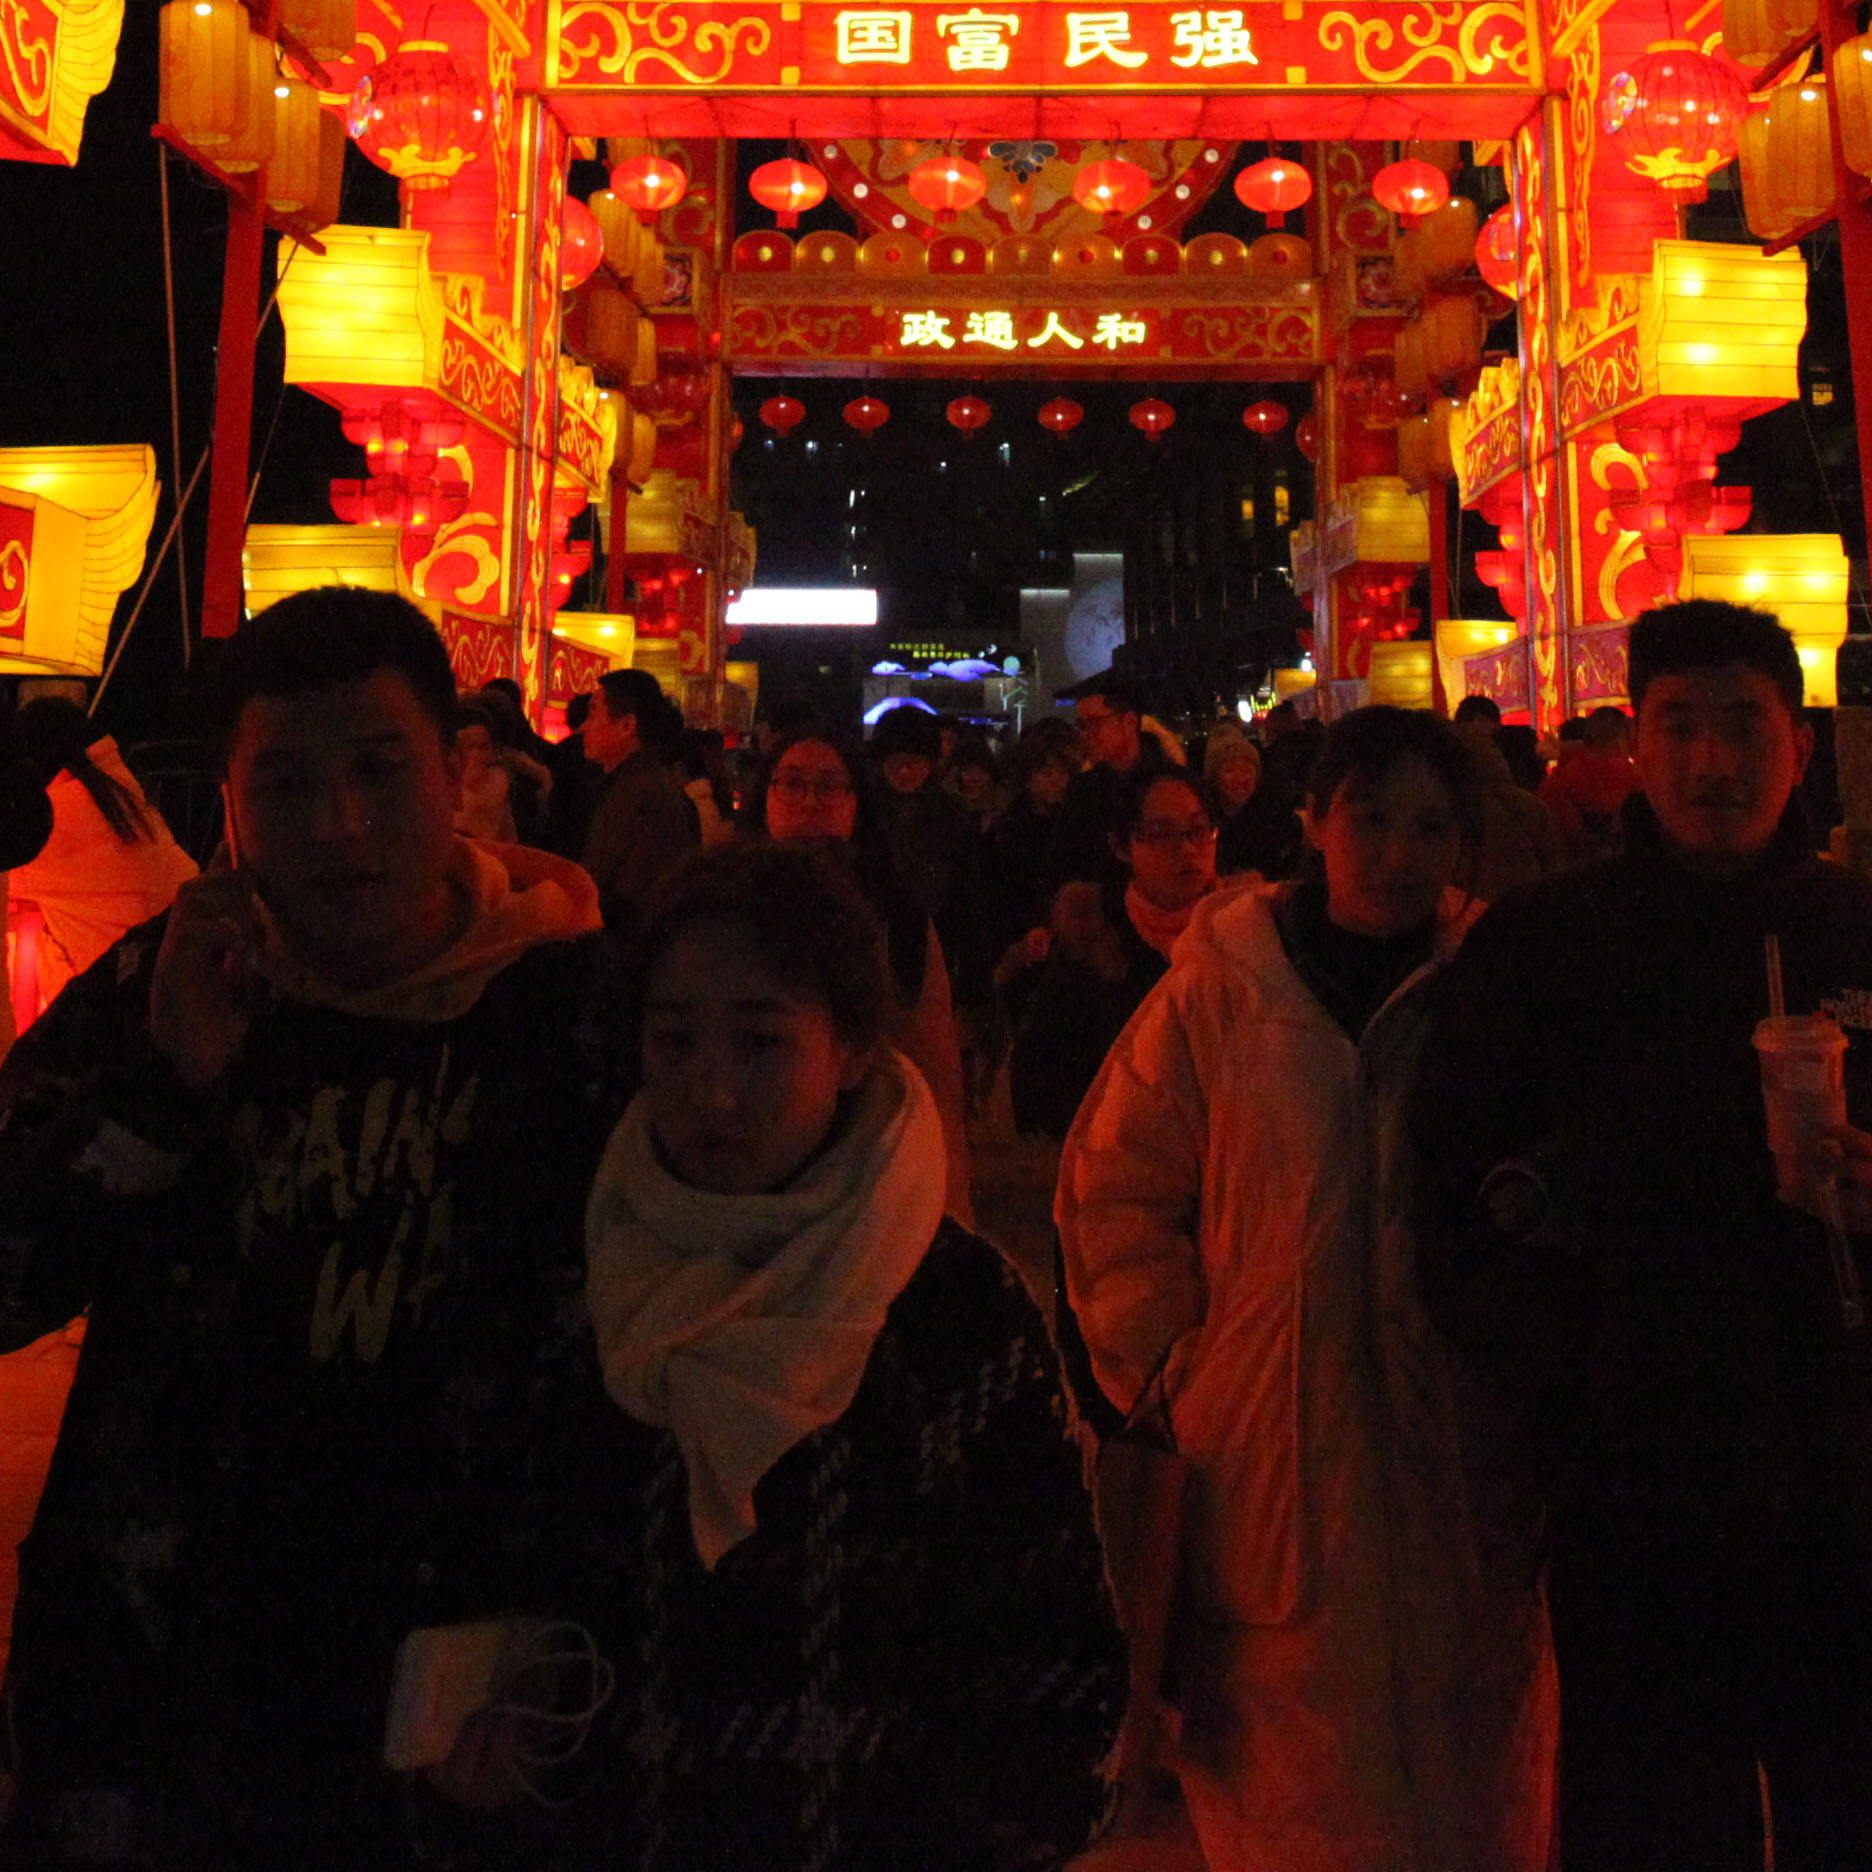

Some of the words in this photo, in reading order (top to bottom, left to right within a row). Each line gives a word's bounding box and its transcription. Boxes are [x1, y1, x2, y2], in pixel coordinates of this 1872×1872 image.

[834, 7, 1259, 72] 国富民强
[899, 310, 1146, 350] 政通人和
